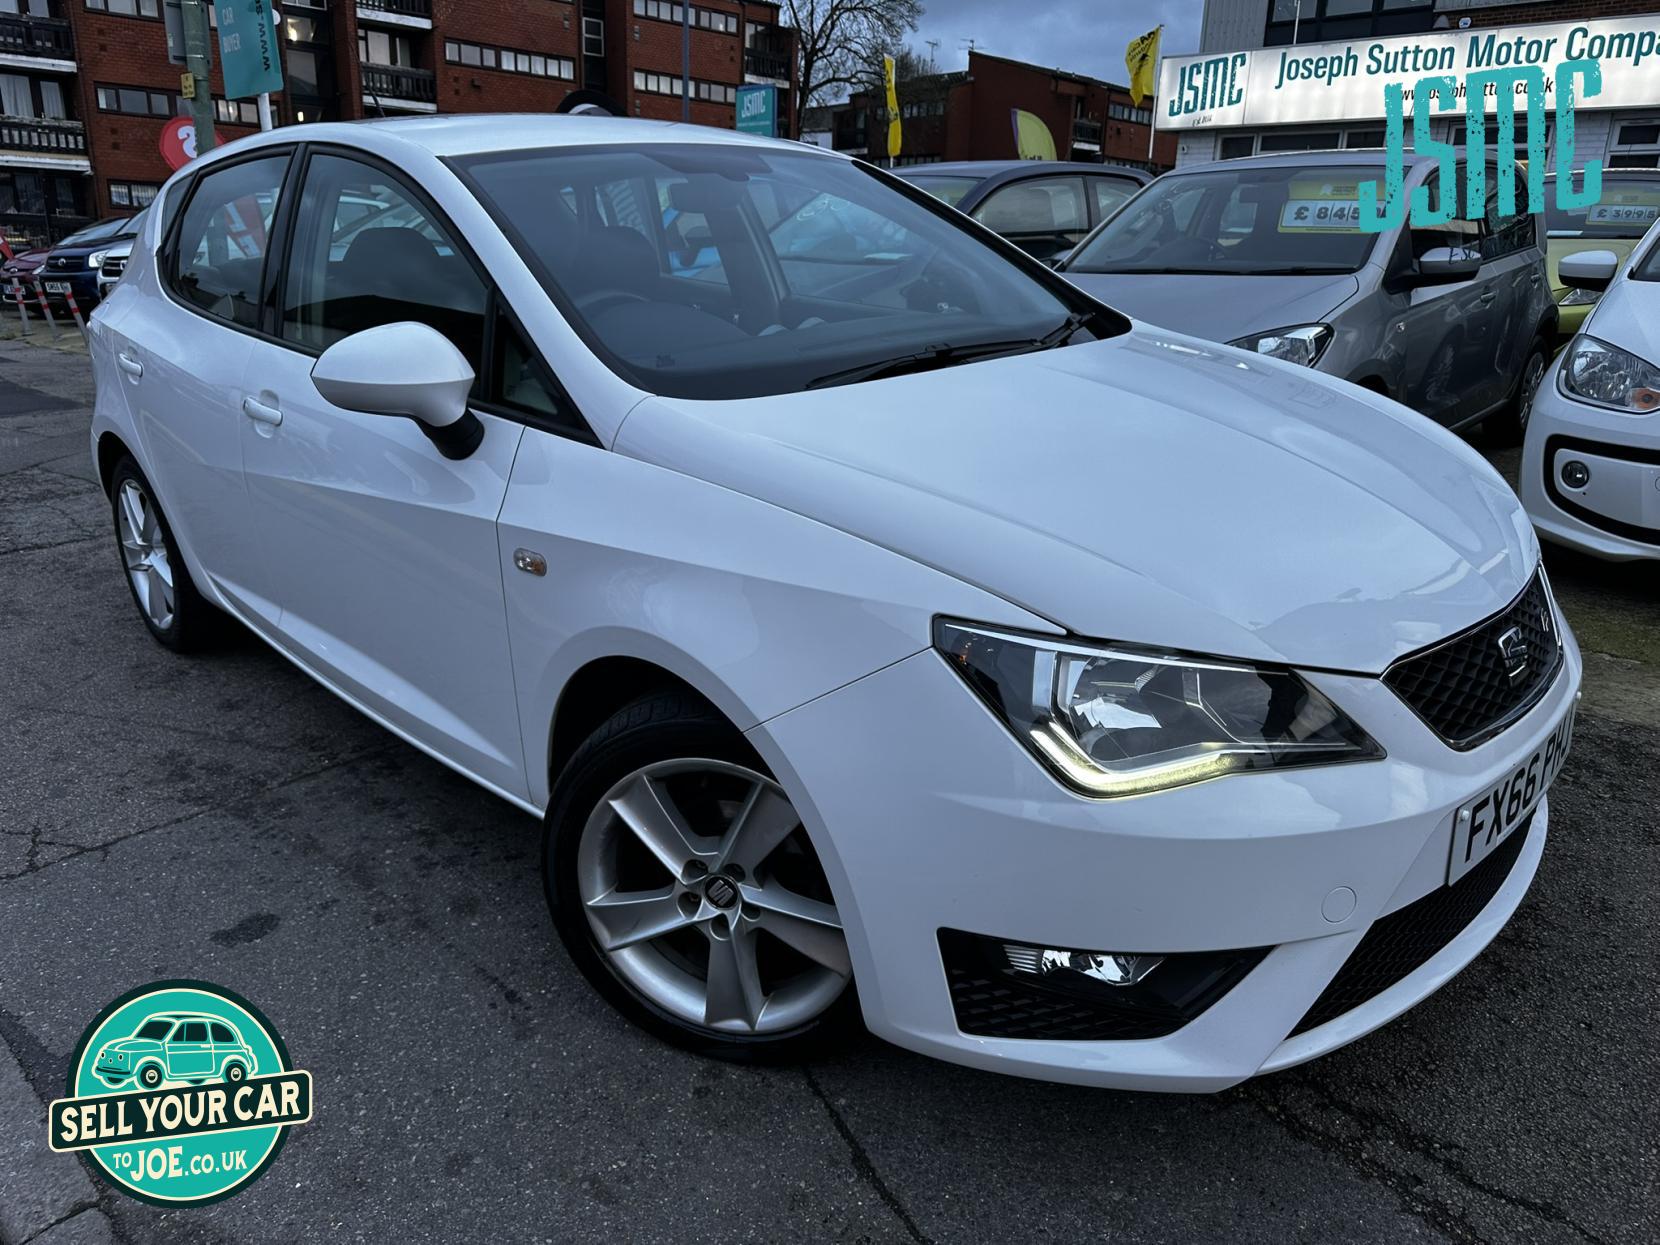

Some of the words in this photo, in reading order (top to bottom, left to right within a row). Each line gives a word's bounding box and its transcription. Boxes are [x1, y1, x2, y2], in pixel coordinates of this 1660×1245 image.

[1168, 53, 1246, 117] JSMC
[1275, 51, 1359, 89] Joseph
[1366, 44, 1455, 76] Sutton
[1466, 34, 1557, 68] Motor
[741, 90, 766, 118] JSMC
[1465, 752, 1540, 863] FX66
